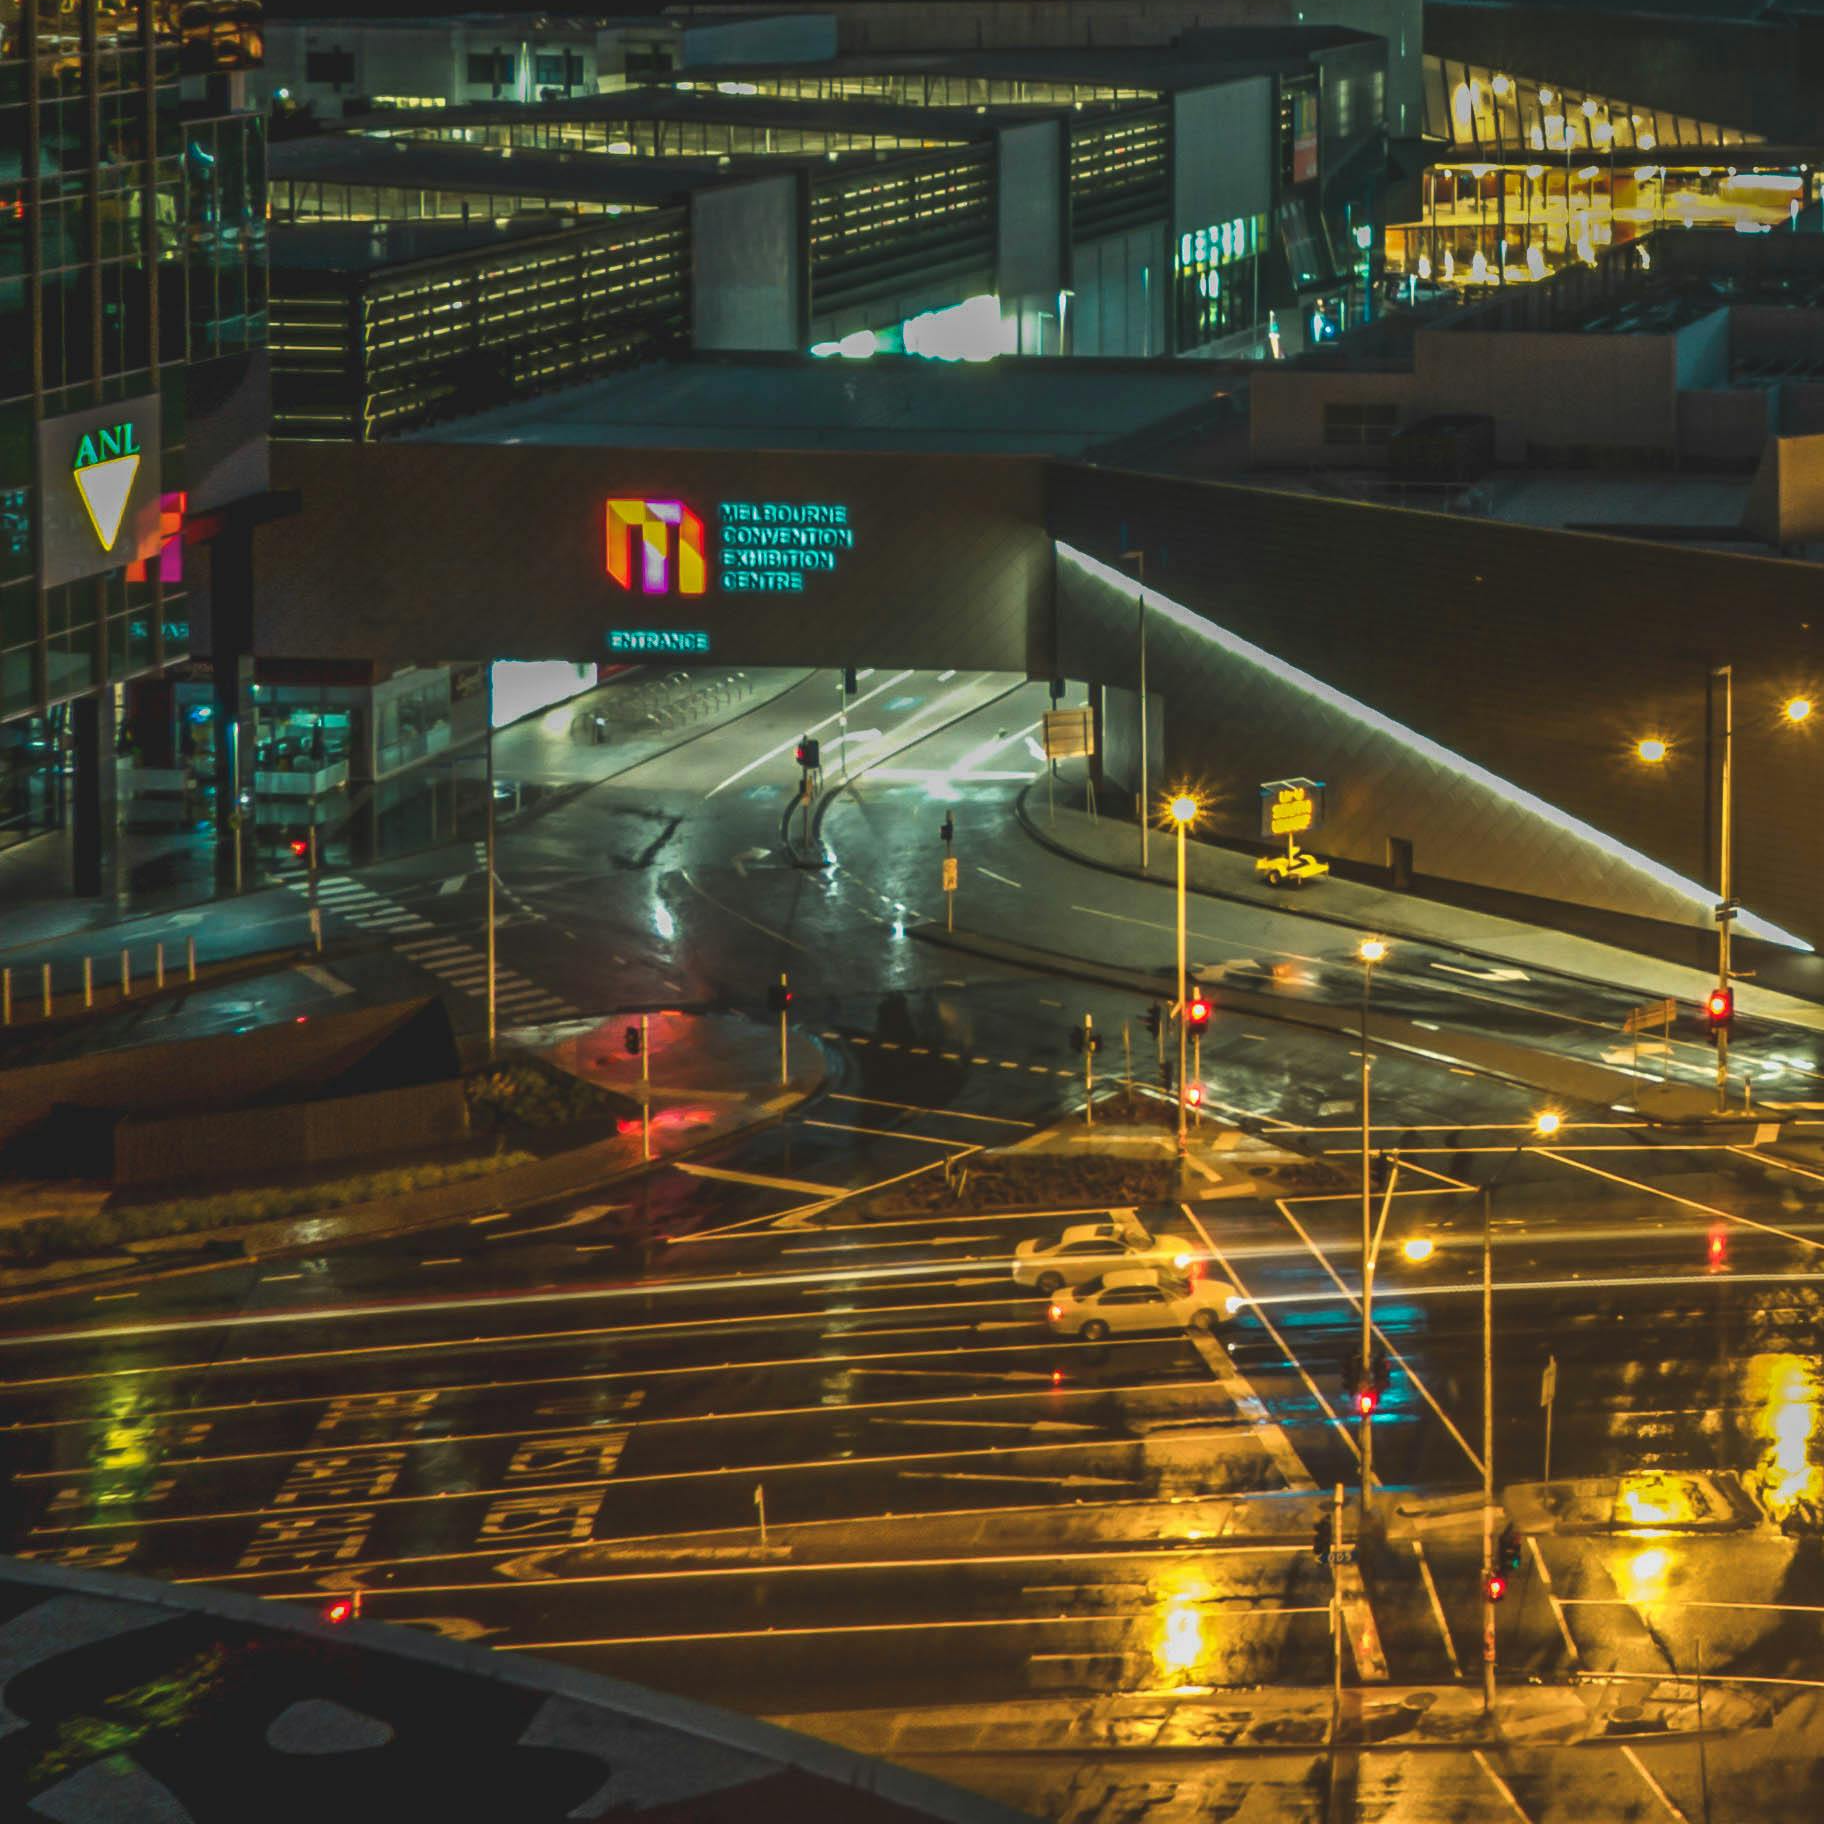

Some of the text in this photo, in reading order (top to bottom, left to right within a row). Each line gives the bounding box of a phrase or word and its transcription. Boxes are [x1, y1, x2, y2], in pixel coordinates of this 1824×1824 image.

[74, 423, 141, 468] ANL
[720, 502, 848, 524] MELBOURNE
[720, 527, 855, 548] CONVENTION
[720, 550, 836, 571] EXHIBITION
[720, 572, 804, 592] CENTRE
[610, 630, 710, 652] ENTRANCE
